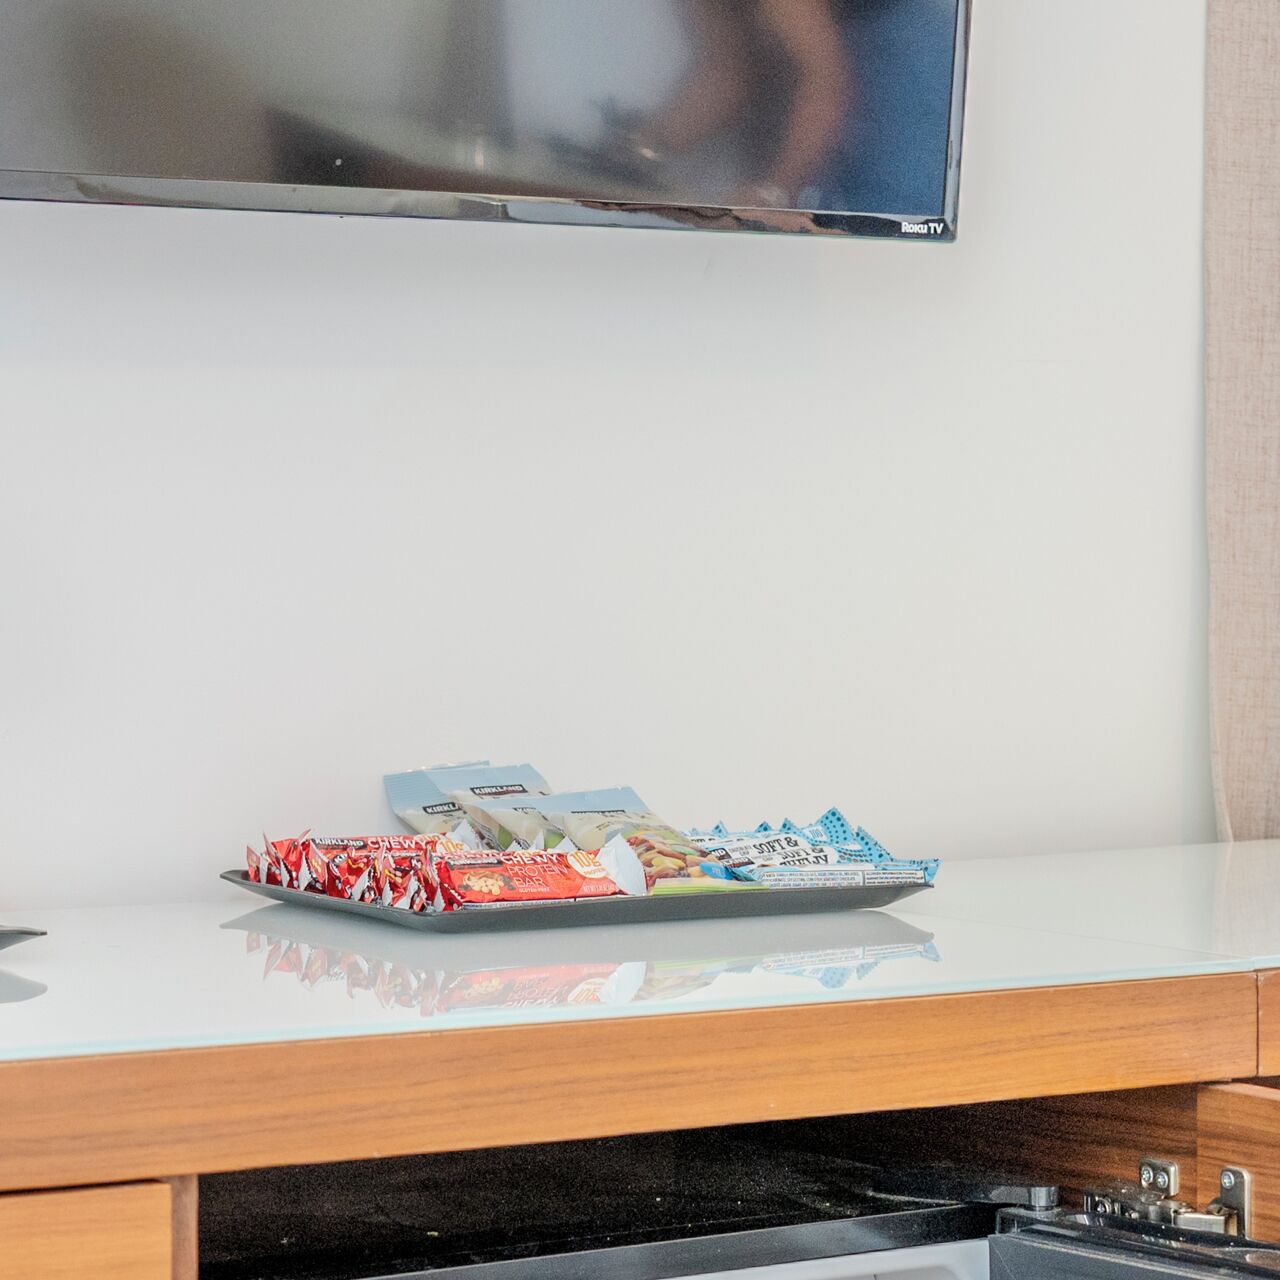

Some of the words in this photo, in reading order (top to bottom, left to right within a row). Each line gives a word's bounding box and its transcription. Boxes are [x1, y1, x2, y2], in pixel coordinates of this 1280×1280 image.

[901, 222, 928, 234] Roku
[928, 223, 944, 234] TV
[473, 785, 524, 795] KIRKLAND
[426, 803, 458, 814] KIRKL
[315, 837, 364, 847] KIRKLAND
[368, 836, 429, 849] CHEWY
[753, 839, 786, 854] SOFT
[501, 853, 560, 865] CHEWY
[508, 864, 569, 877] PROTEIN
[514, 877, 545, 888] BAR
